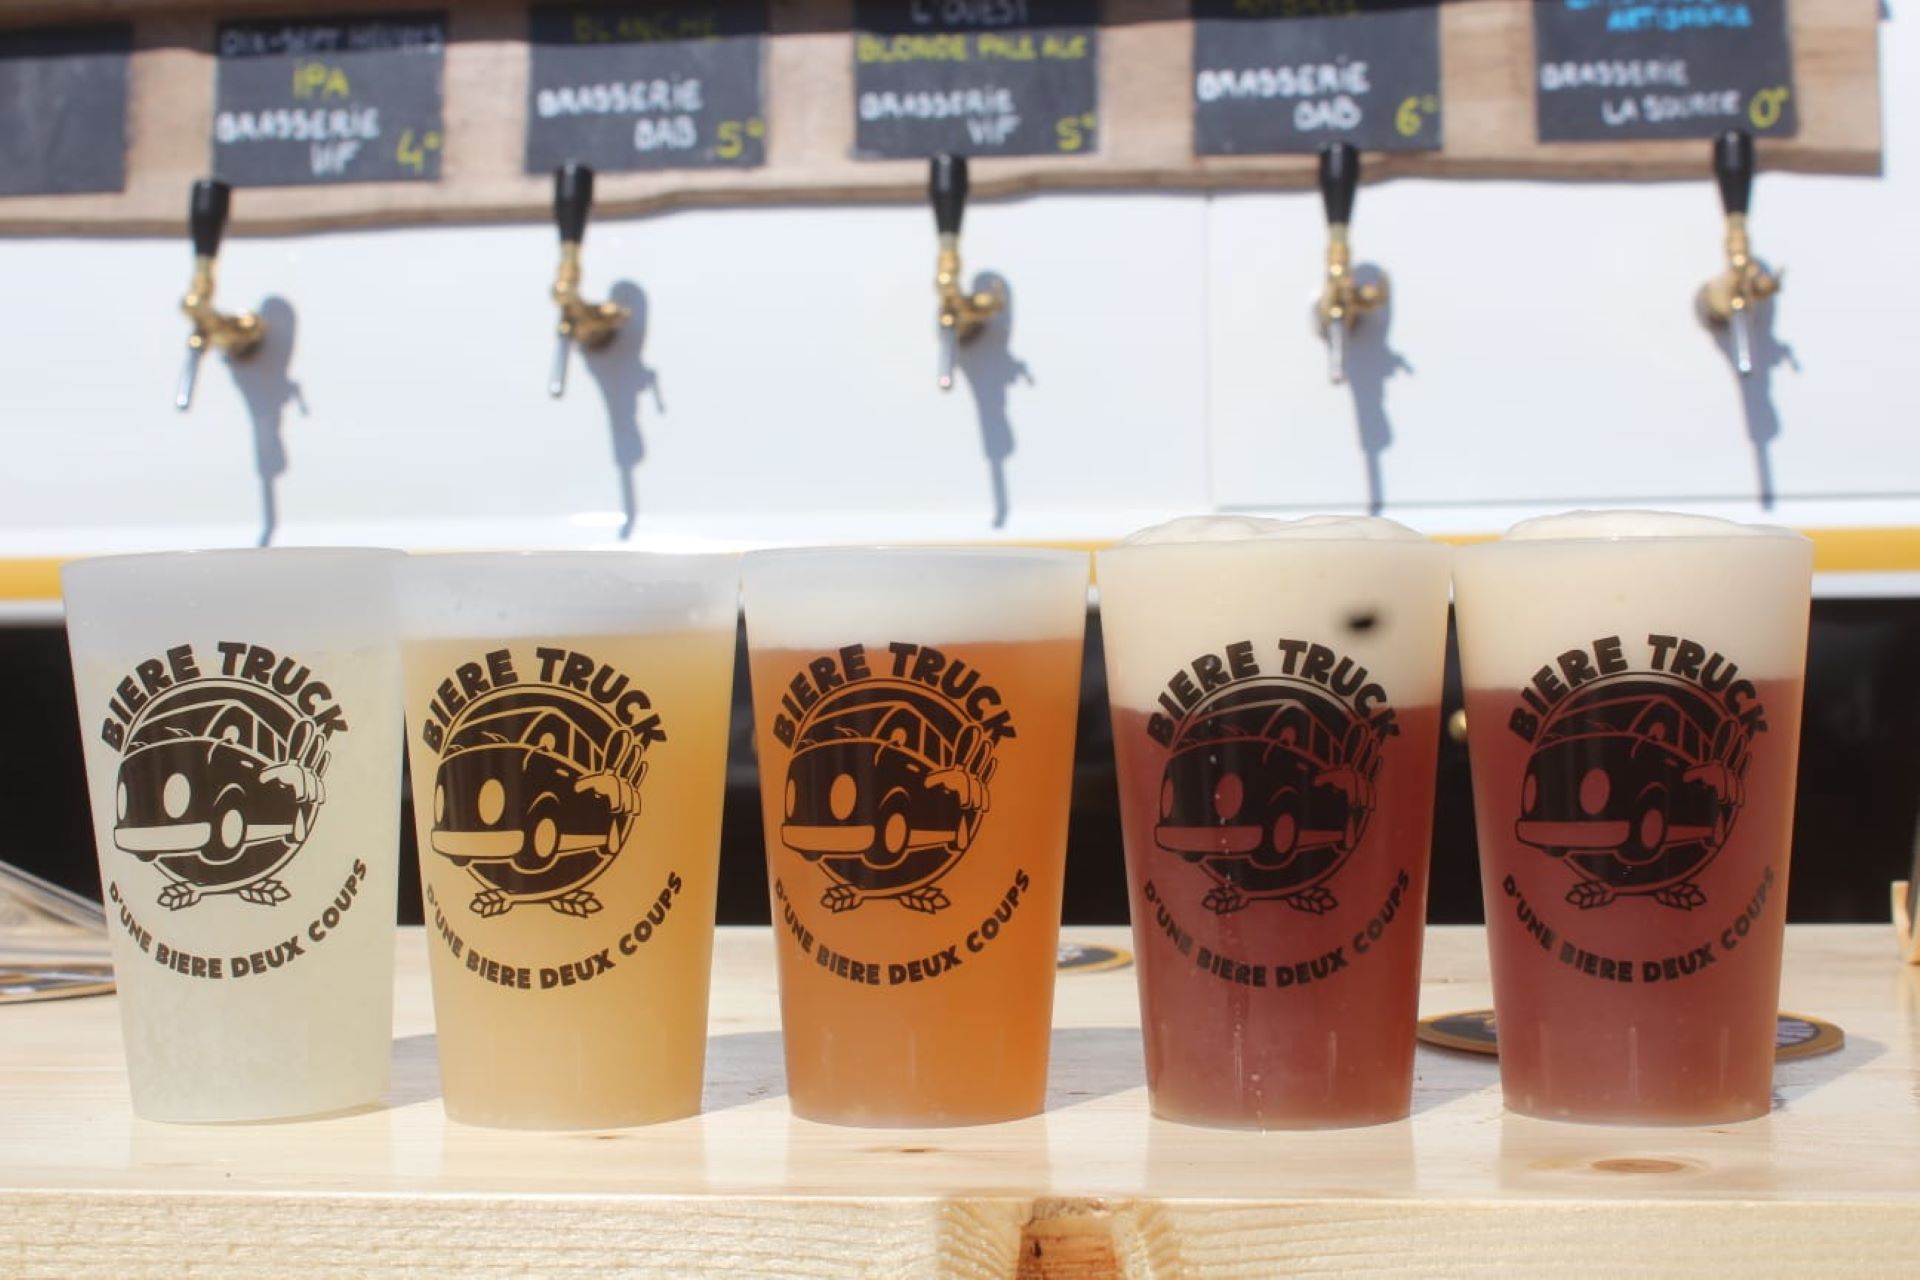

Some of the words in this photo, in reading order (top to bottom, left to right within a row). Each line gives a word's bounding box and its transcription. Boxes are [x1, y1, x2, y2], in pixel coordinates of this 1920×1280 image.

[293, 61, 350, 98] IPA
[857, 34, 967, 63] BLONDE
[978, 33, 1036, 61] PALE
[1042, 34, 1088, 59] ALE
[1601, 95, 1639, 125] LA
[1641, 90, 1740, 122] SOURCE
[101, 644, 201, 752] BIERE
[218, 641, 349, 743] TRUCK
[423, 648, 518, 753] BIERE
[536, 647, 668, 750] TRUCK
[773, 643, 872, 750] BIERE
[889, 642, 1017, 750] TRUCK
[1147, 640, 1260, 750] BIERE
[1278, 638, 1400, 741] TRUCK
[1508, 635, 1628, 744] BIERE
[1647, 634, 1768, 740] TRUCK
[110, 881, 152, 954] D'UNE
[155, 942, 223, 979] BIERE
[231, 936, 305, 979] DEUX
[308, 858, 367, 942] COUPS
[427, 883, 464, 958] D'UNE
[466, 949, 531, 989] BIERE
[540, 948, 616, 989] DEUX
[619, 872, 682, 956] COUPS
[775, 878, 814, 953] D'UNE
[816, 944, 880, 985] BIERE
[889, 945, 963, 986] DEUX
[966, 869, 1030, 953] COUPS
[1144, 880, 1193, 957] D'UNE
[1197, 946, 1266, 987] BIERE
[1275, 948, 1348, 987] DEUX
[1353, 869, 1409, 953] COUPS
[1502, 874, 1555, 950] D'UNE
[1559, 941, 1633, 983] BIERE
[1642, 944, 1717, 982] DEUX
[1721, 864, 1775, 950] COUPS
